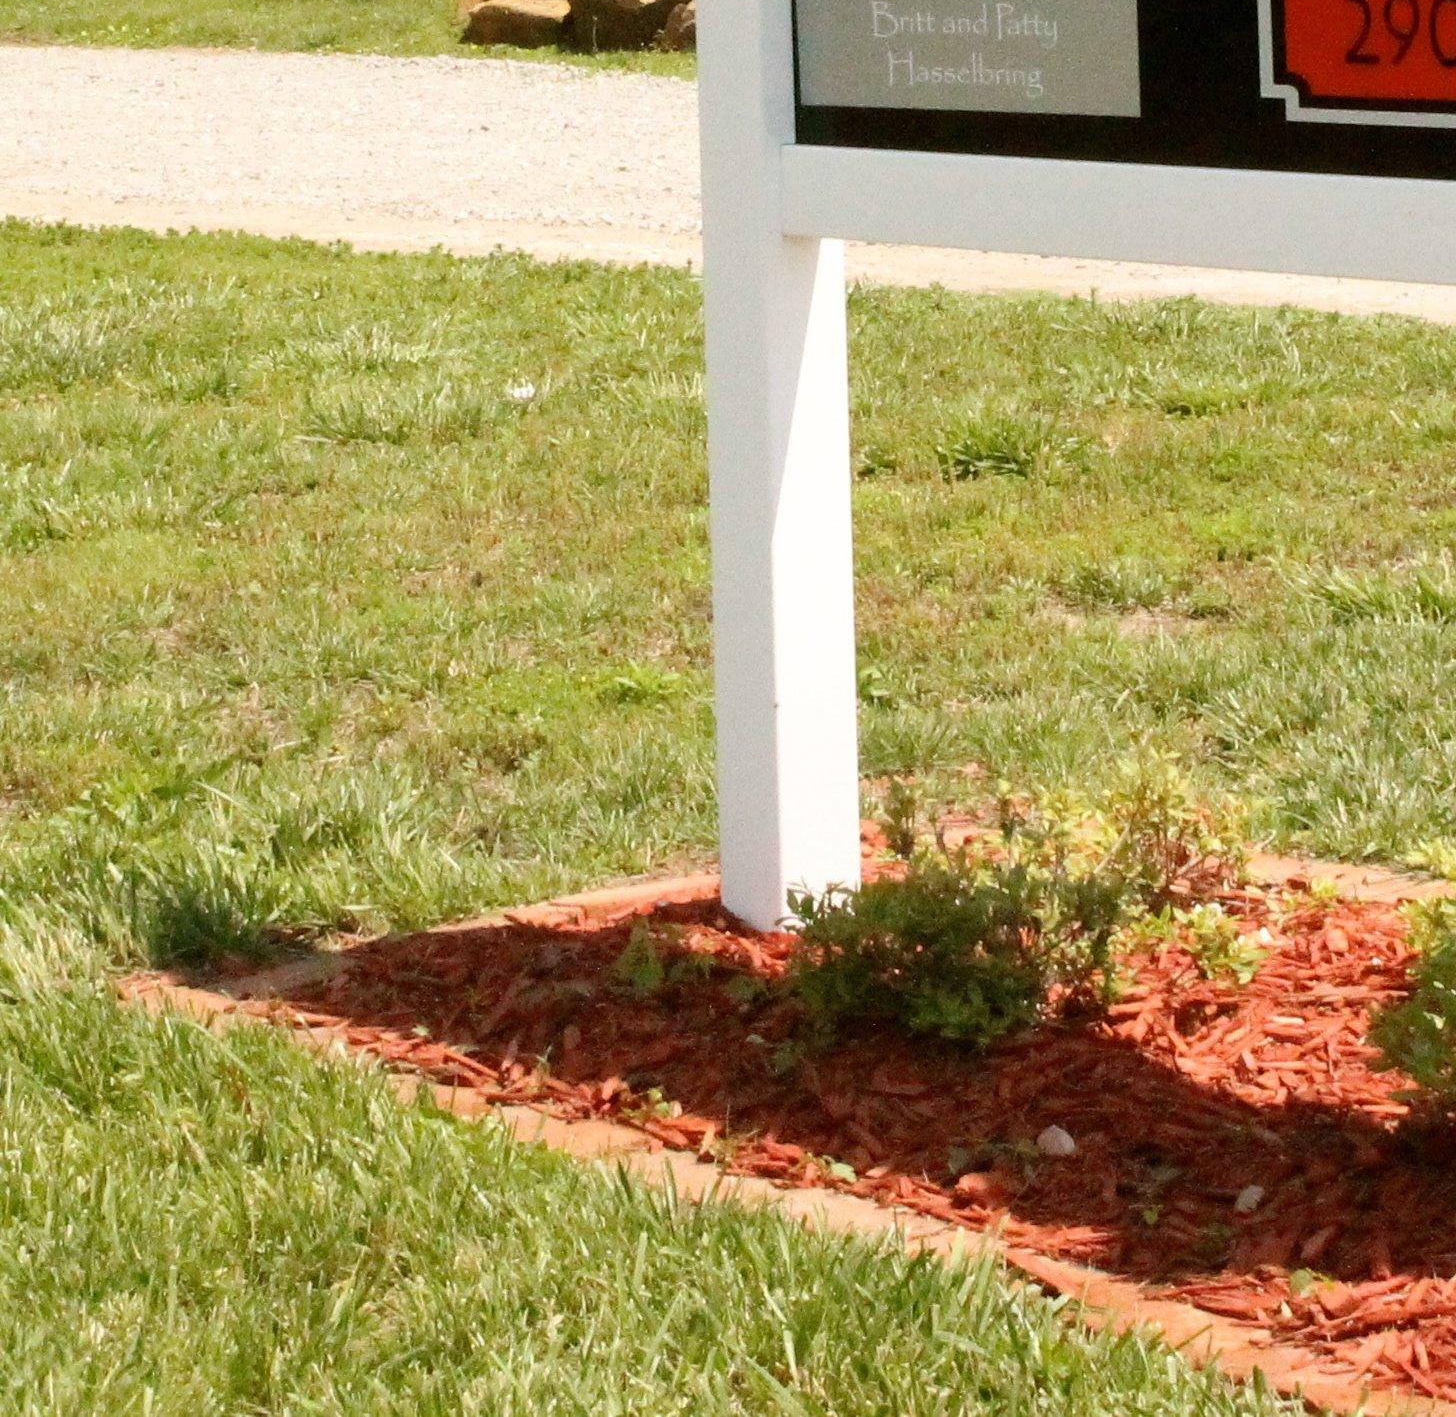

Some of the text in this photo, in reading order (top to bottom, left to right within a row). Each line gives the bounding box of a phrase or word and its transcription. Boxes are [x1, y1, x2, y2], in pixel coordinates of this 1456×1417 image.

[870, 0, 1059, 49] Britt and Patty
[887, 49, 1044, 99] Hasselbring
